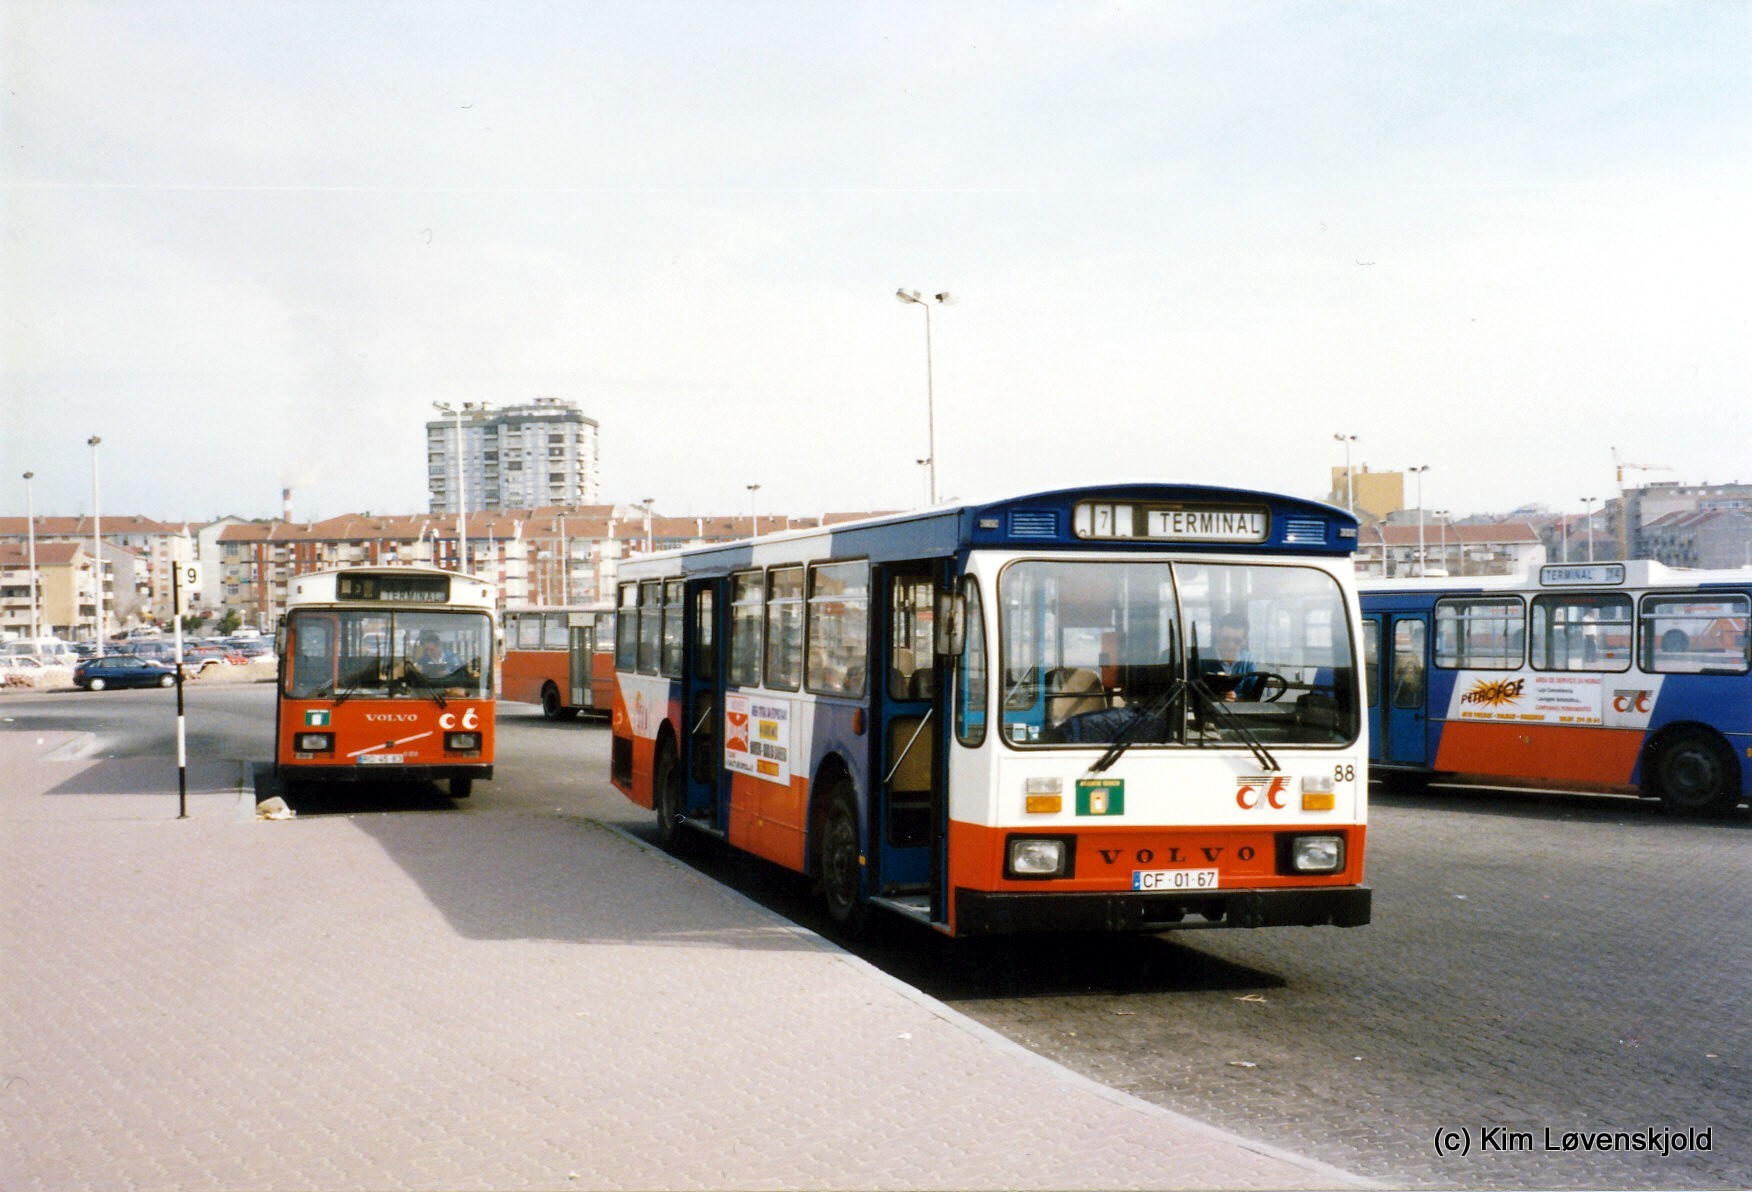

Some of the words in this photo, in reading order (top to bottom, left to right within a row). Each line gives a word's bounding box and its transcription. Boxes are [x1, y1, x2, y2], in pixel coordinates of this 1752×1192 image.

[1101, 511, 1108, 529] 7
[1160, 512, 1261, 535] TERMINAL
[187, 567, 197, 584] 9
[1546, 569, 1592, 581] TERMINAL
[384, 592, 444, 602] TERMINAL
[365, 714, 418, 722] VOLVO
[1334, 765, 1356, 782] 88
[1098, 846, 1256, 865] VOLVO
